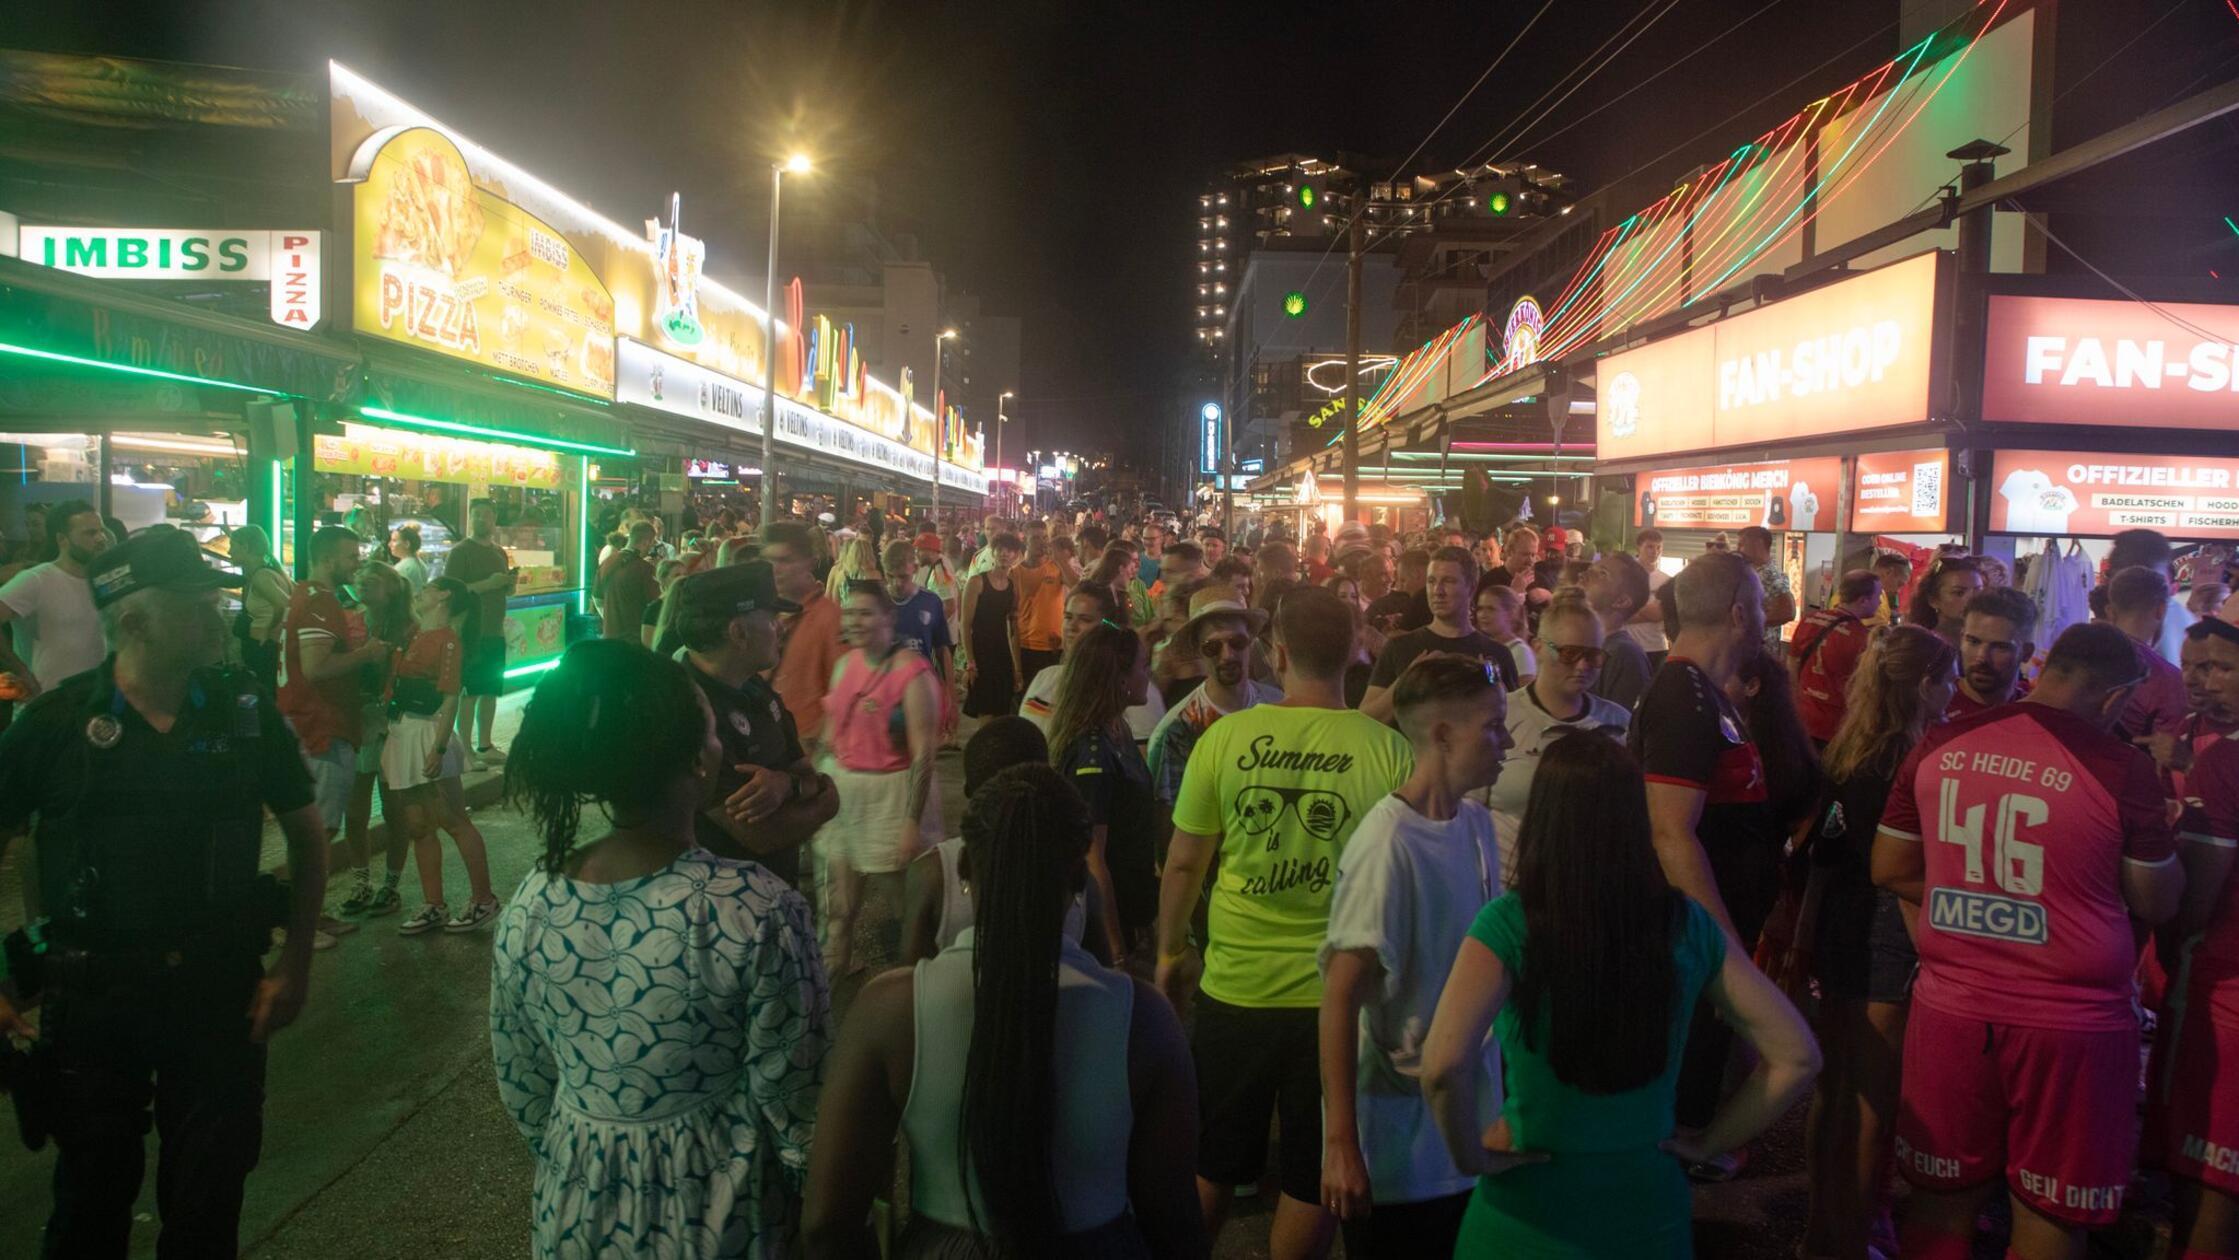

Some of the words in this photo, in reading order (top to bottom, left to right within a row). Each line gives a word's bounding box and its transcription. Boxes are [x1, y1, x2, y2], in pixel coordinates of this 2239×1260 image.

[43, 237, 249, 272] IMBISS
[283, 236, 309, 322] PIZZA
[383, 272, 479, 350] PIZZA
[1720, 319, 1901, 411] FAN-SHOP
[2025, 336, 2239, 393] FAN-S
[711, 383, 743, 419] VELTINS
[787, 410, 808, 438] VELTINS
[1750, 470, 1788, 488] MERCH
[2066, 464, 2230, 489] OFFIZIELLER
[2101, 497, 2185, 508] BADELATSCHEN
[2120, 515, 2167, 524] T-SHIRTS
[1237, 735, 1353, 774] Summer
[1940, 751, 1966, 771] SC
[1971, 752, 2037, 782] HEIDE
[2040, 767, 2073, 792] 69
[1265, 829, 1280, 851] is
[1938, 778, 2049, 896] 46
[1241, 856, 1331, 895] calling
[1933, 894, 2041, 936] MEGD
[1914, 1150, 1960, 1178] EUCH
[2019, 1168, 2060, 1204] GEIL
[2065, 1183, 2126, 1211] DICHT
